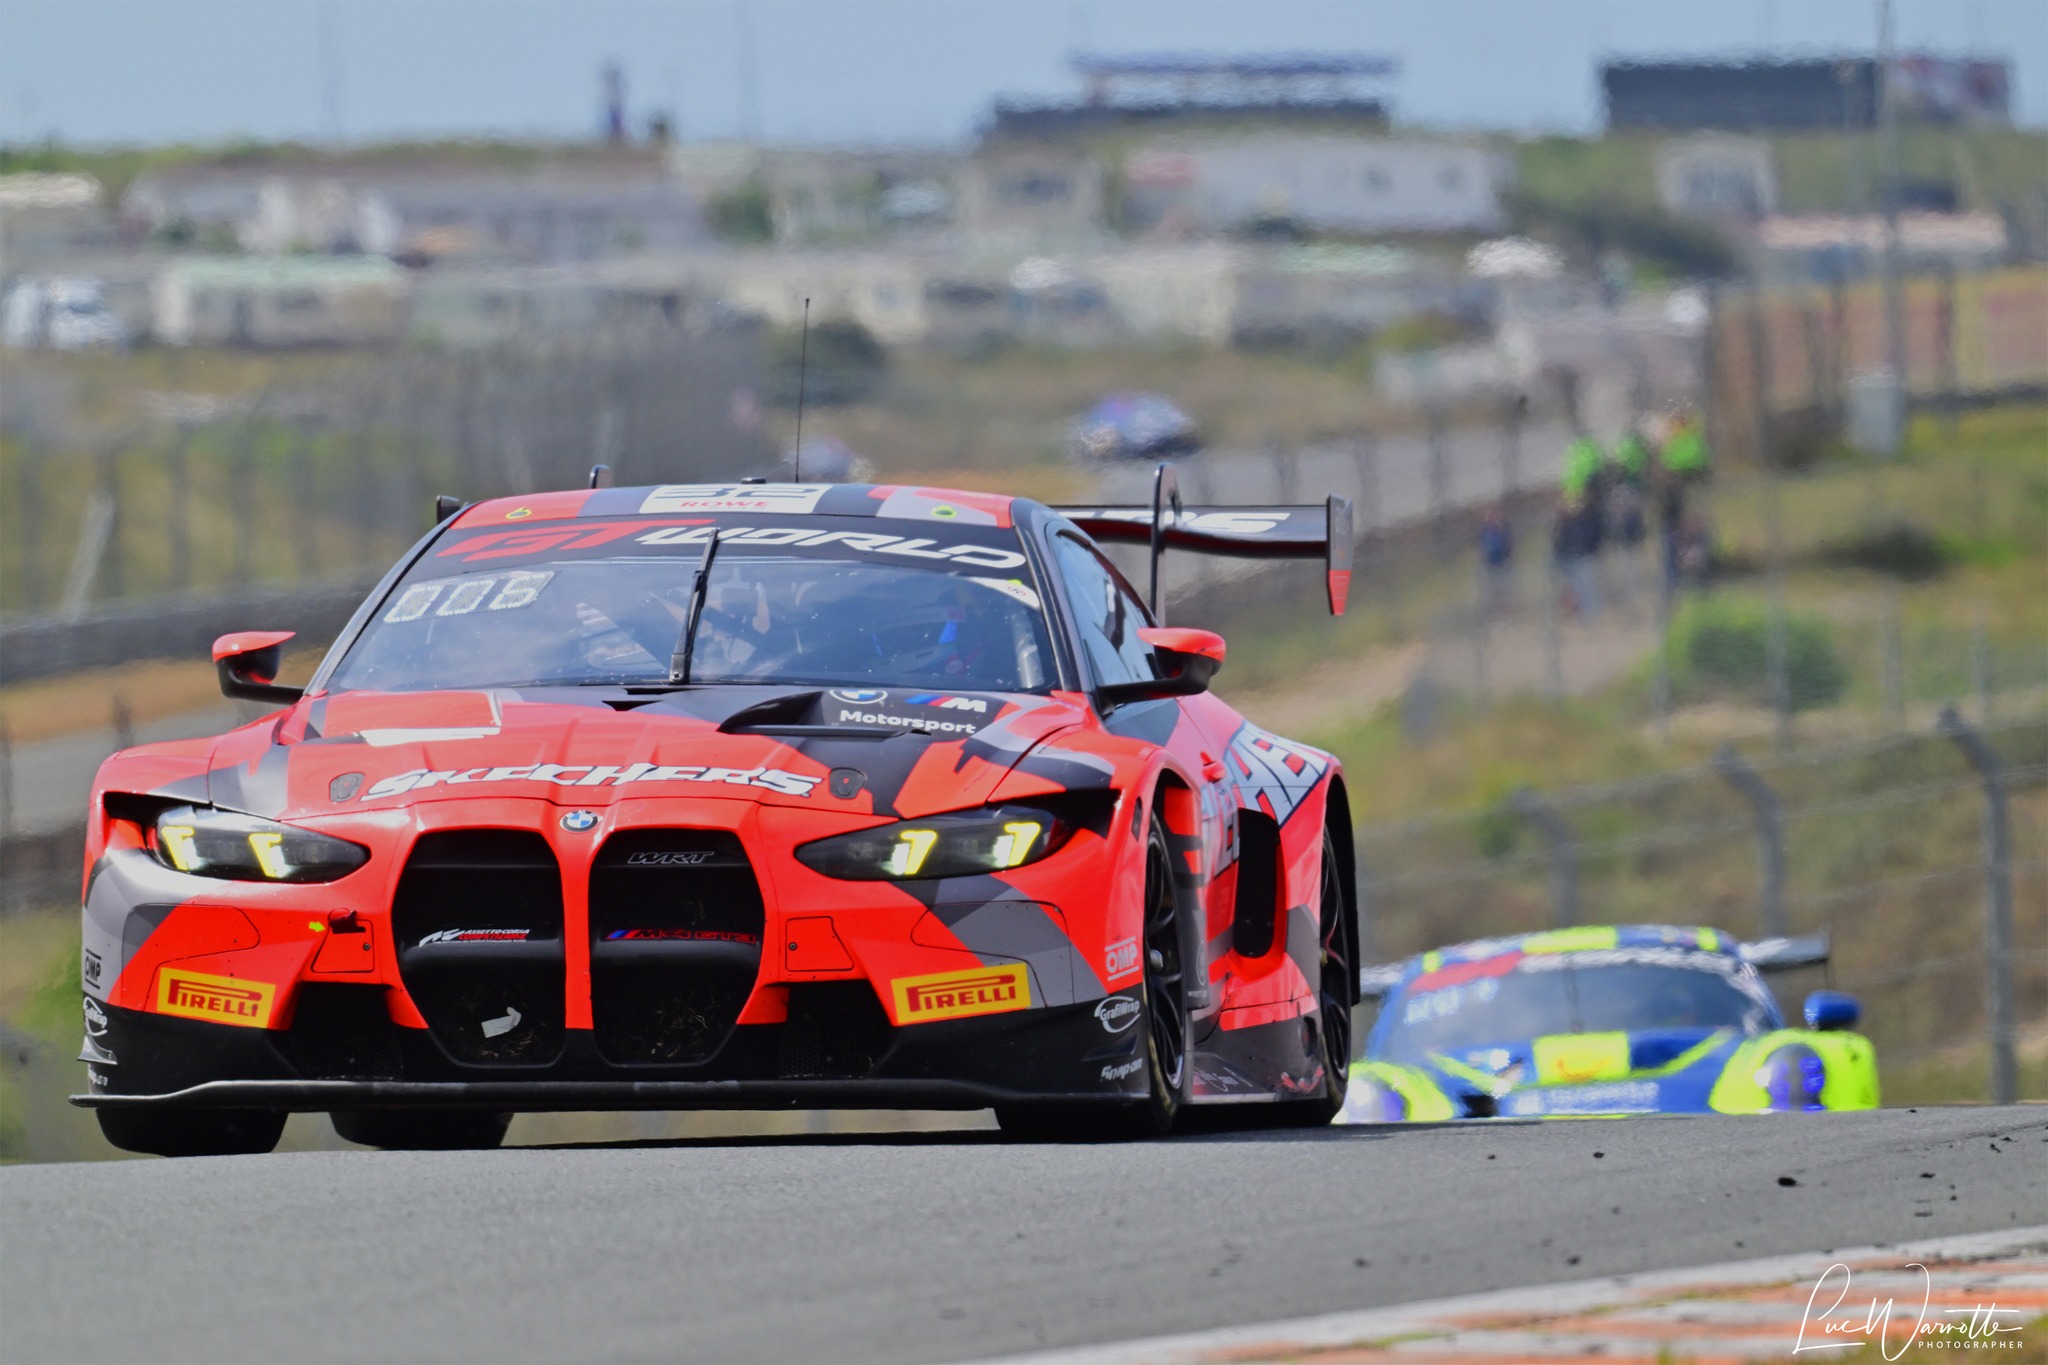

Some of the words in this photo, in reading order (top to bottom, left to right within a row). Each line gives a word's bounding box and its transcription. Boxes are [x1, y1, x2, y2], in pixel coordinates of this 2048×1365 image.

[635, 527, 1027, 568] WORLD
[840, 710, 976, 734] Motorsport
[360, 763, 824, 801] SKECHERS
[627, 851, 714, 865] WRT
[1106, 943, 1138, 974] OMP
[167, 978, 262, 1018] PIRELLI
[906, 974, 1017, 1013] PIRELLI
